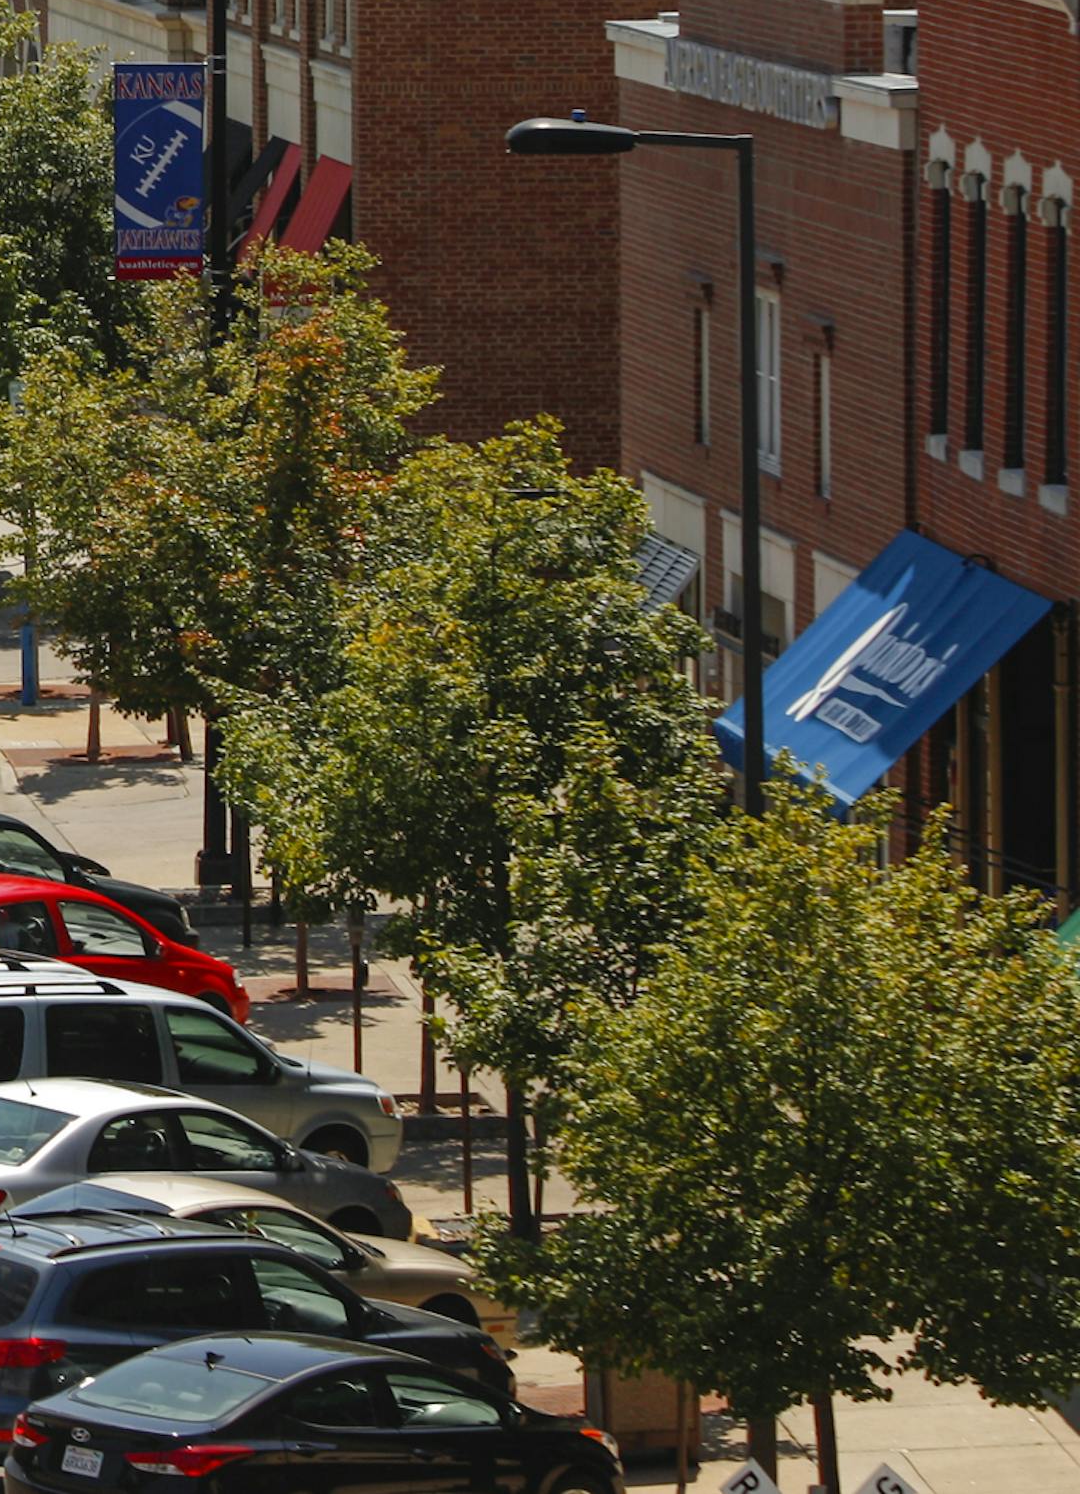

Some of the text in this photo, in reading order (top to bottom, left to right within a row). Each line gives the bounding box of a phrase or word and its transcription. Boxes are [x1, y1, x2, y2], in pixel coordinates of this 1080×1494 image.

[117, 72, 202, 100] KANSAS
[129, 134, 157, 166] KU
[116, 228, 201, 256] JAYHAWKS
